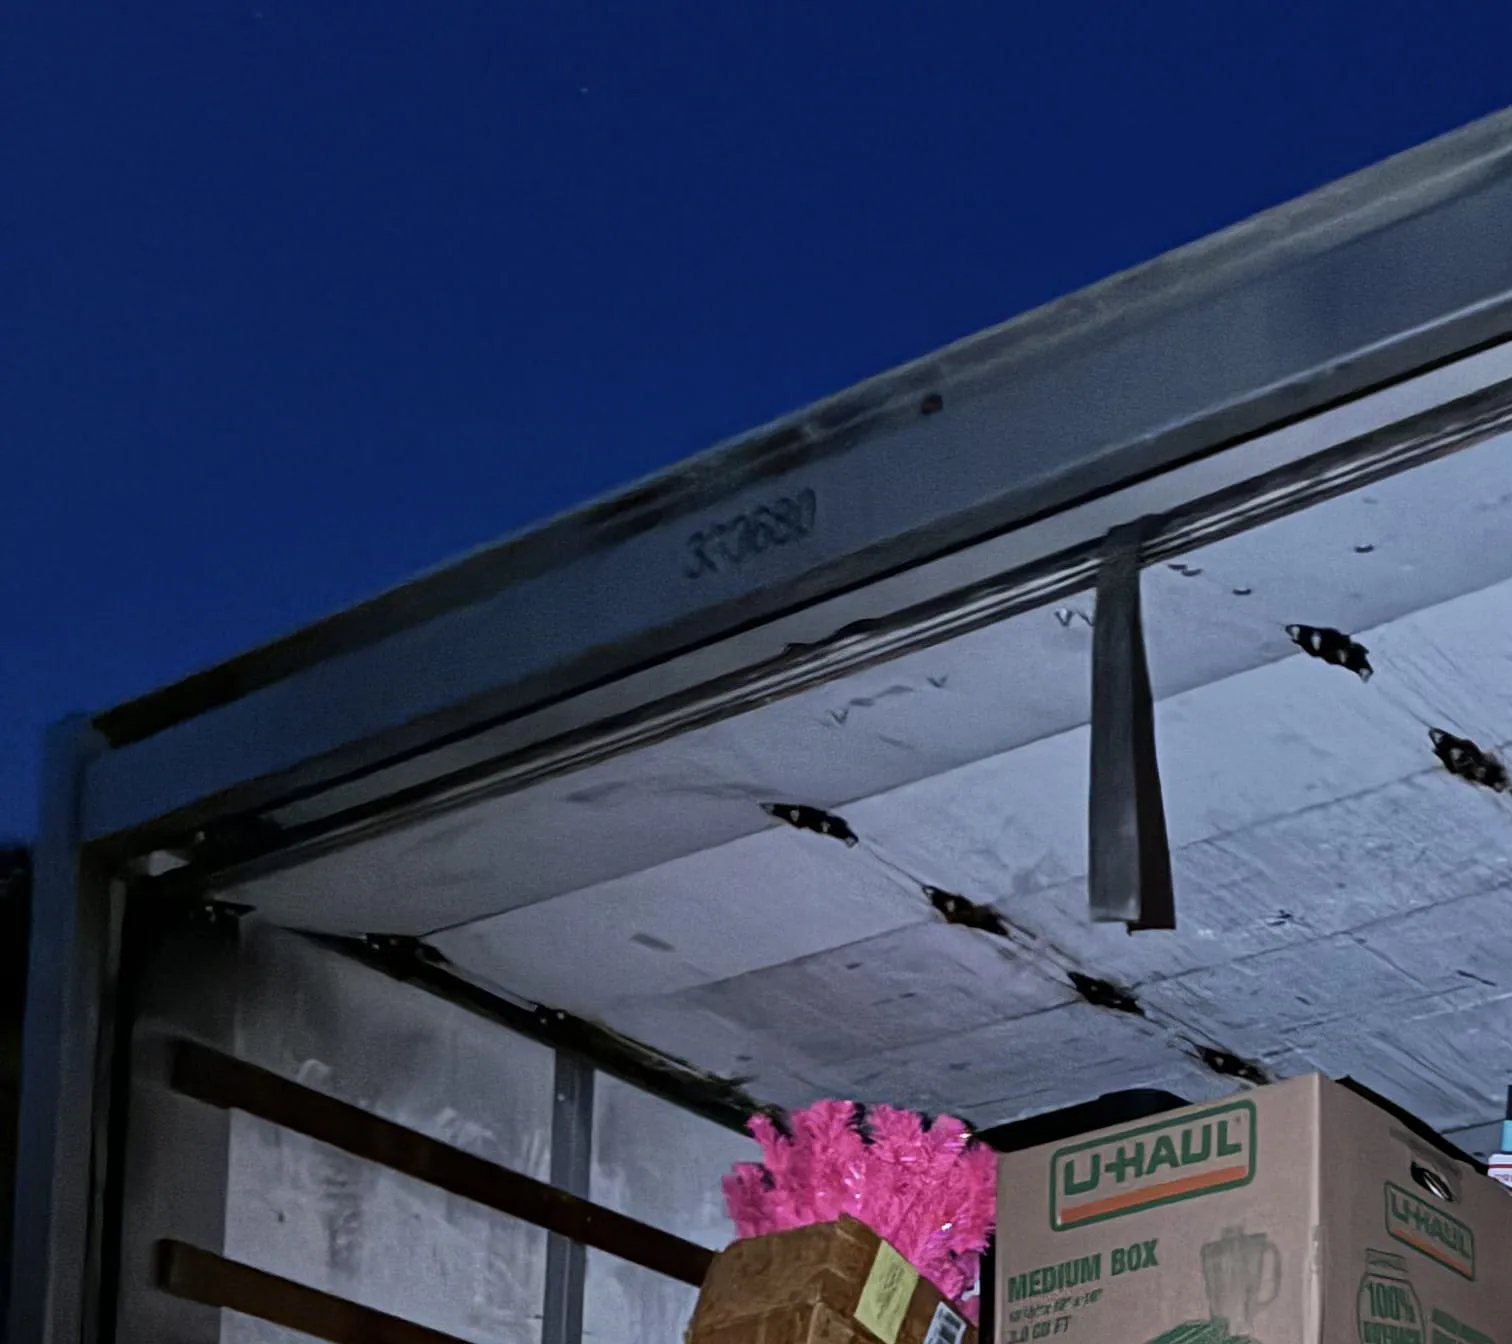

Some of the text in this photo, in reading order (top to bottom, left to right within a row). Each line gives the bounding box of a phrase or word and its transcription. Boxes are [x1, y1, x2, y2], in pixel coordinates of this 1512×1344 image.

[1064, 1120, 1243, 1196] U-HAUL
[1007, 1239, 1160, 1303] MEDIUM BOX
